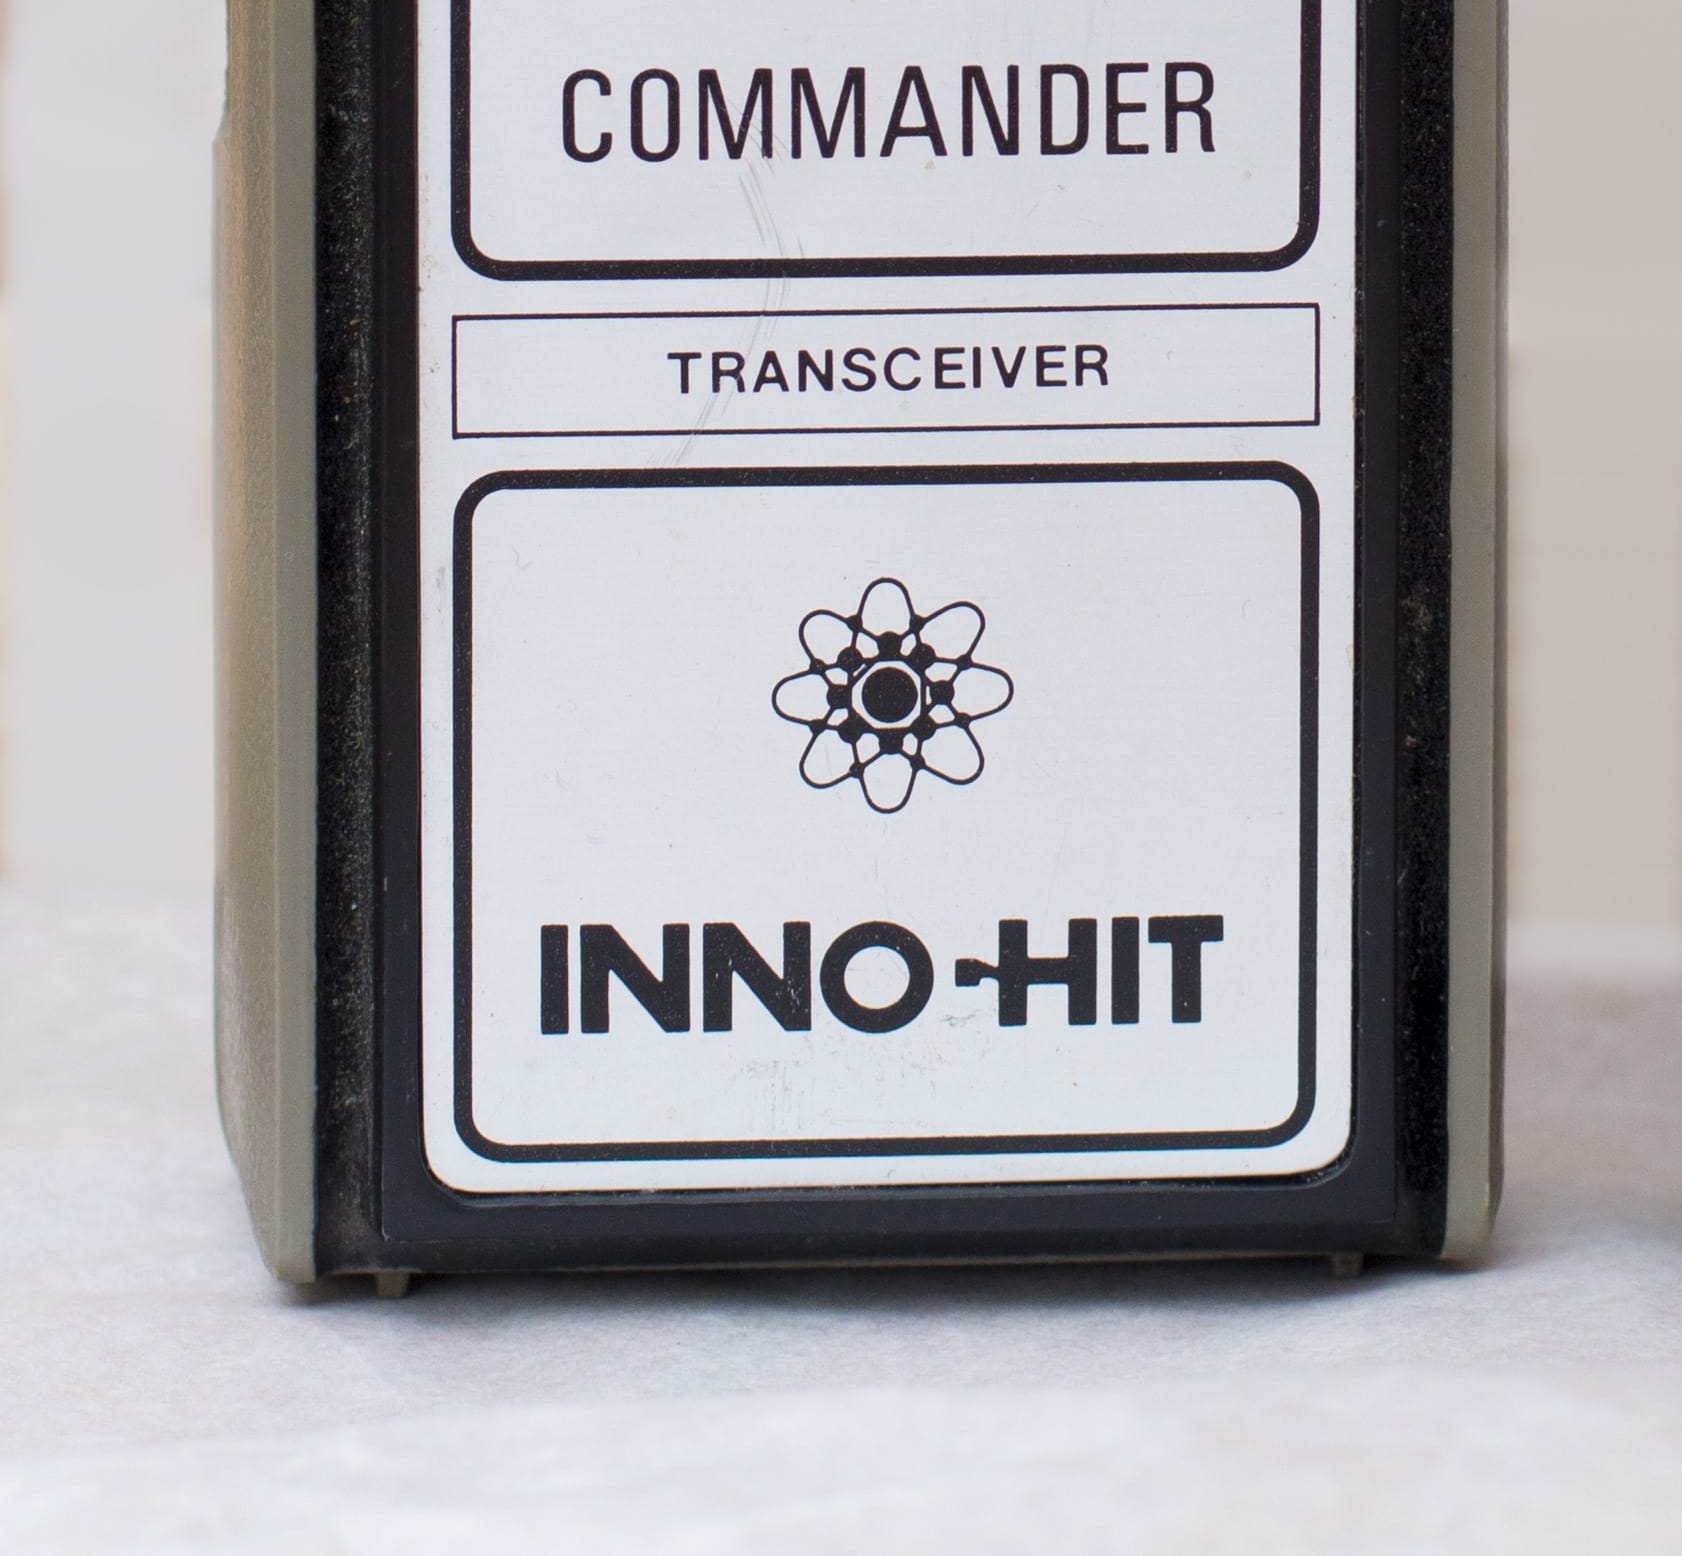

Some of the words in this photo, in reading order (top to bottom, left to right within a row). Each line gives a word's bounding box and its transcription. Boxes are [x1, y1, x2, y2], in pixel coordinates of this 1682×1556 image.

[561, 61, 1216, 164] COMMANDER
[666, 343, 1109, 395] TRANSCEIVER
[539, 914, 1225, 1036] INNO-HIT
